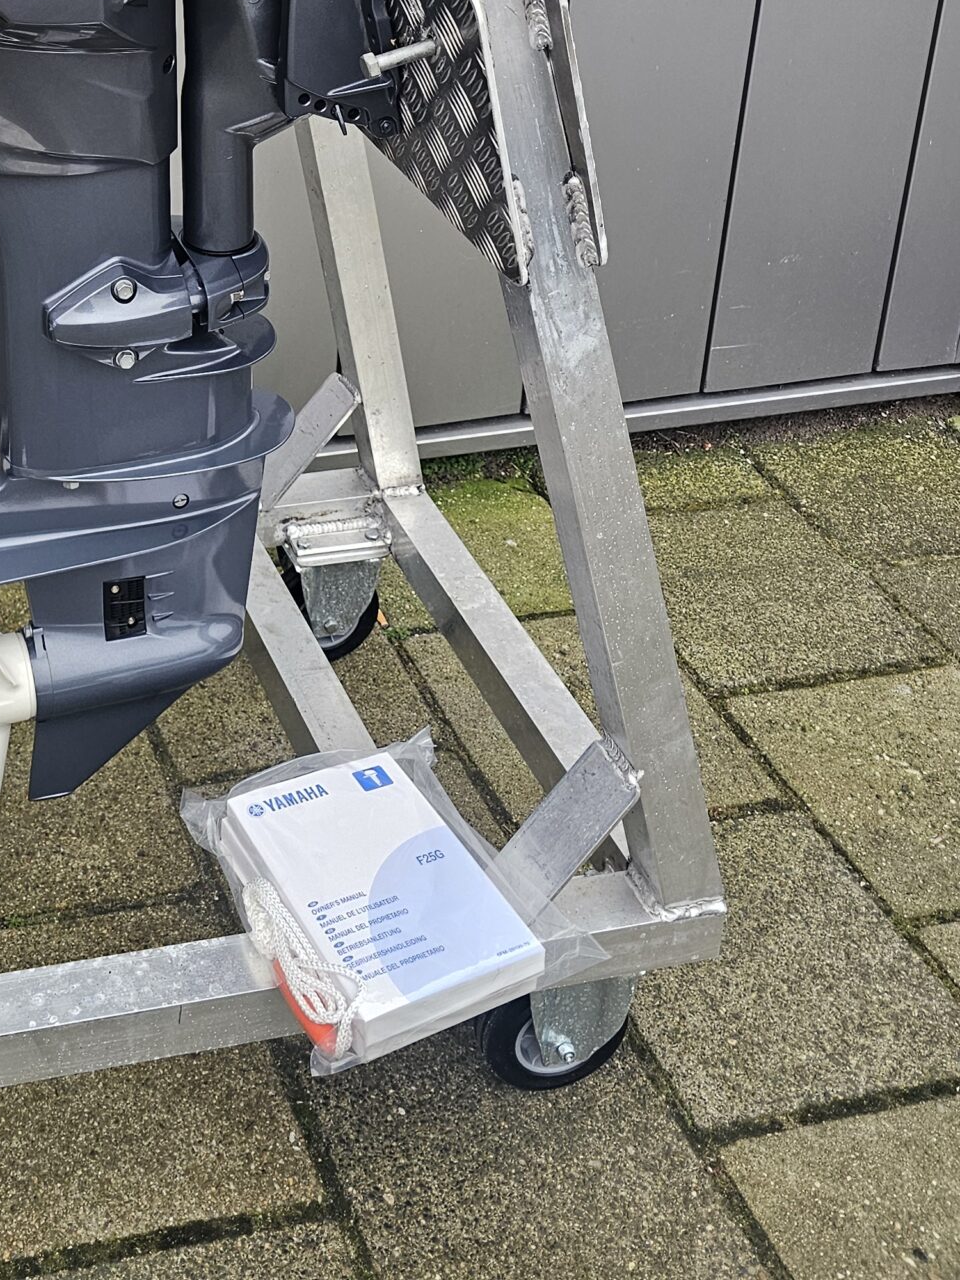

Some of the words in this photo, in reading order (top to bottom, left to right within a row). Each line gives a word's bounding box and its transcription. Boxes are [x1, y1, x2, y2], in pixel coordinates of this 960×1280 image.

[263, 783, 329, 812] YAMAHA
[416, 849, 445, 866] F25G
[311, 899, 340, 916] OWNER'S
[340, 891, 367, 904] MANUAL
[320, 914, 346, 929] MANUEL
[348, 910, 355, 918] DE
[356, 895, 400, 915] L'UTILISATEUR
[328, 927, 355, 942] MANUAL
[355, 922, 369, 933] DEL
[369, 908, 409, 926] PROPIETARIO
[337, 927, 402, 956] BETRIEBSANLEITUNG
[360, 966, 387, 981] ANUALE
[387, 962, 400, 972] DEL
[400, 945, 445, 967] PROPRIETARIO
